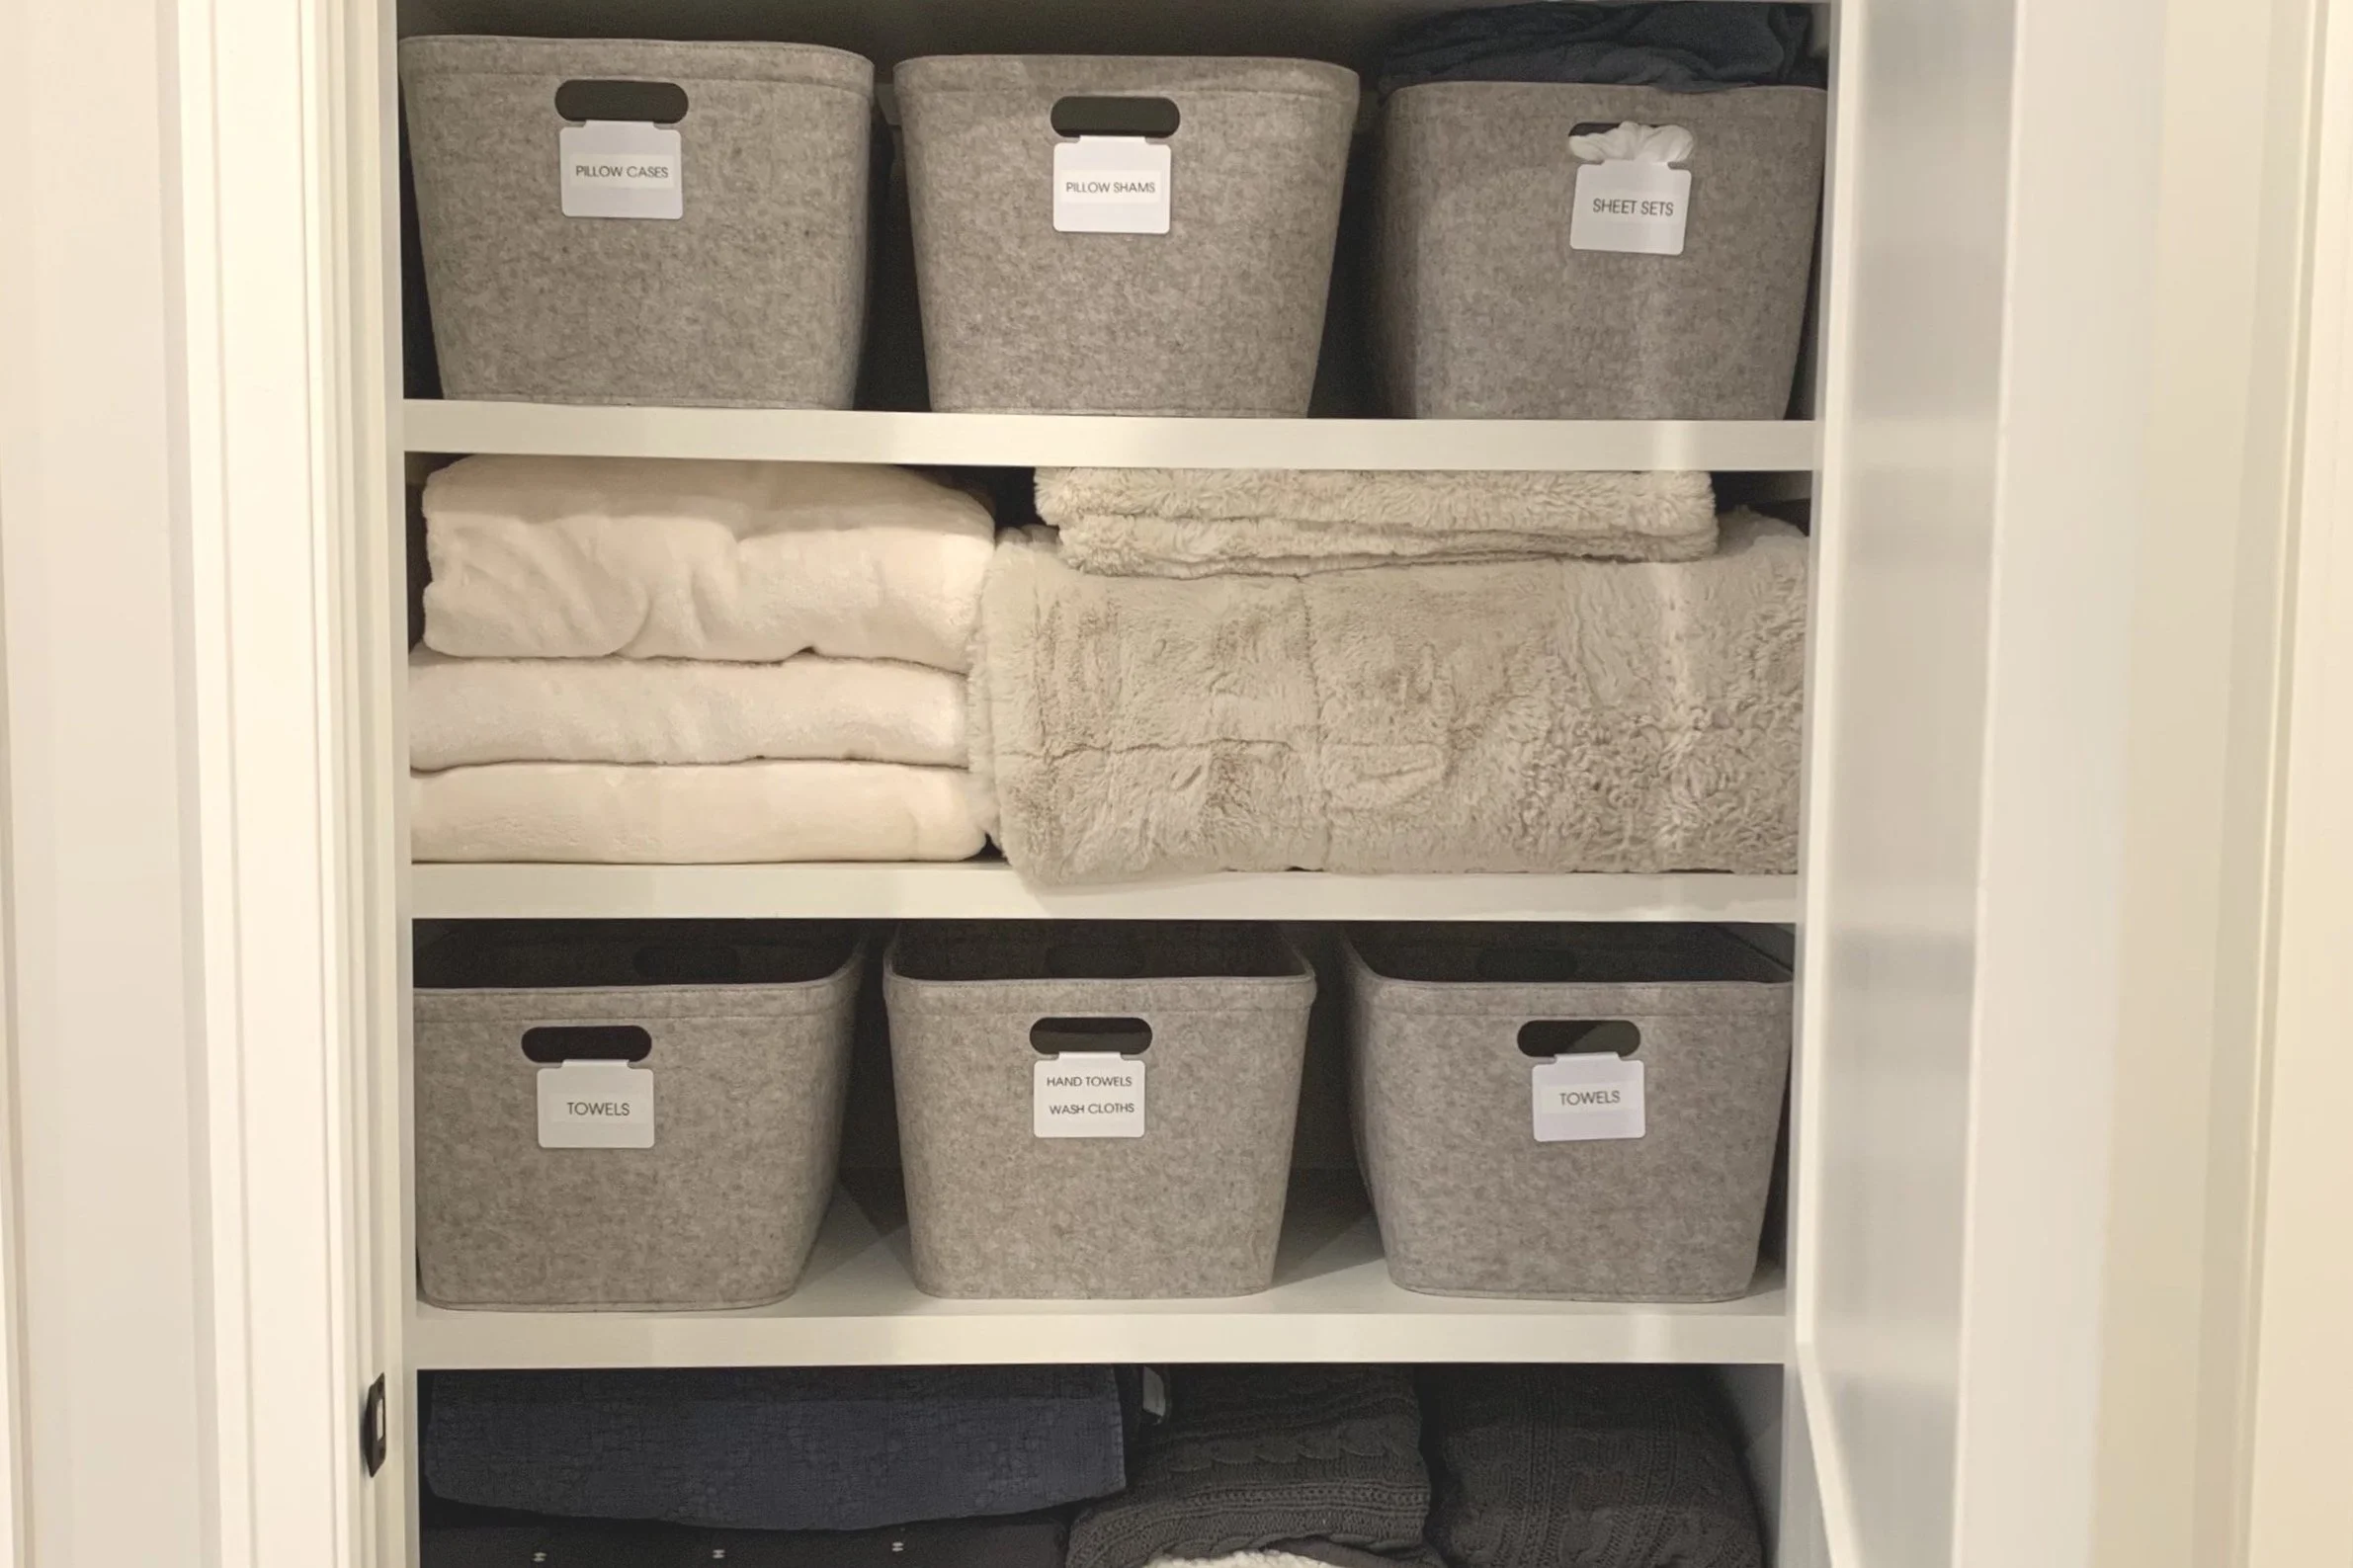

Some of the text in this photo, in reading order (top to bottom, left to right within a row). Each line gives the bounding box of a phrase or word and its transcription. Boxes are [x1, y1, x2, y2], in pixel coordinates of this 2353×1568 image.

[575, 164, 669, 178] PILLOW CASES
[1065, 181, 1156, 194] PILLOW SHAMS
[1591, 198, 1674, 217] SHEET SETS
[1047, 1076, 1134, 1088] HAND TOWELS
[1559, 1090, 1621, 1106] TOWELS
[566, 1102, 631, 1117] TOWELS
[1049, 1102, 1135, 1115] WASH CLOTHS
